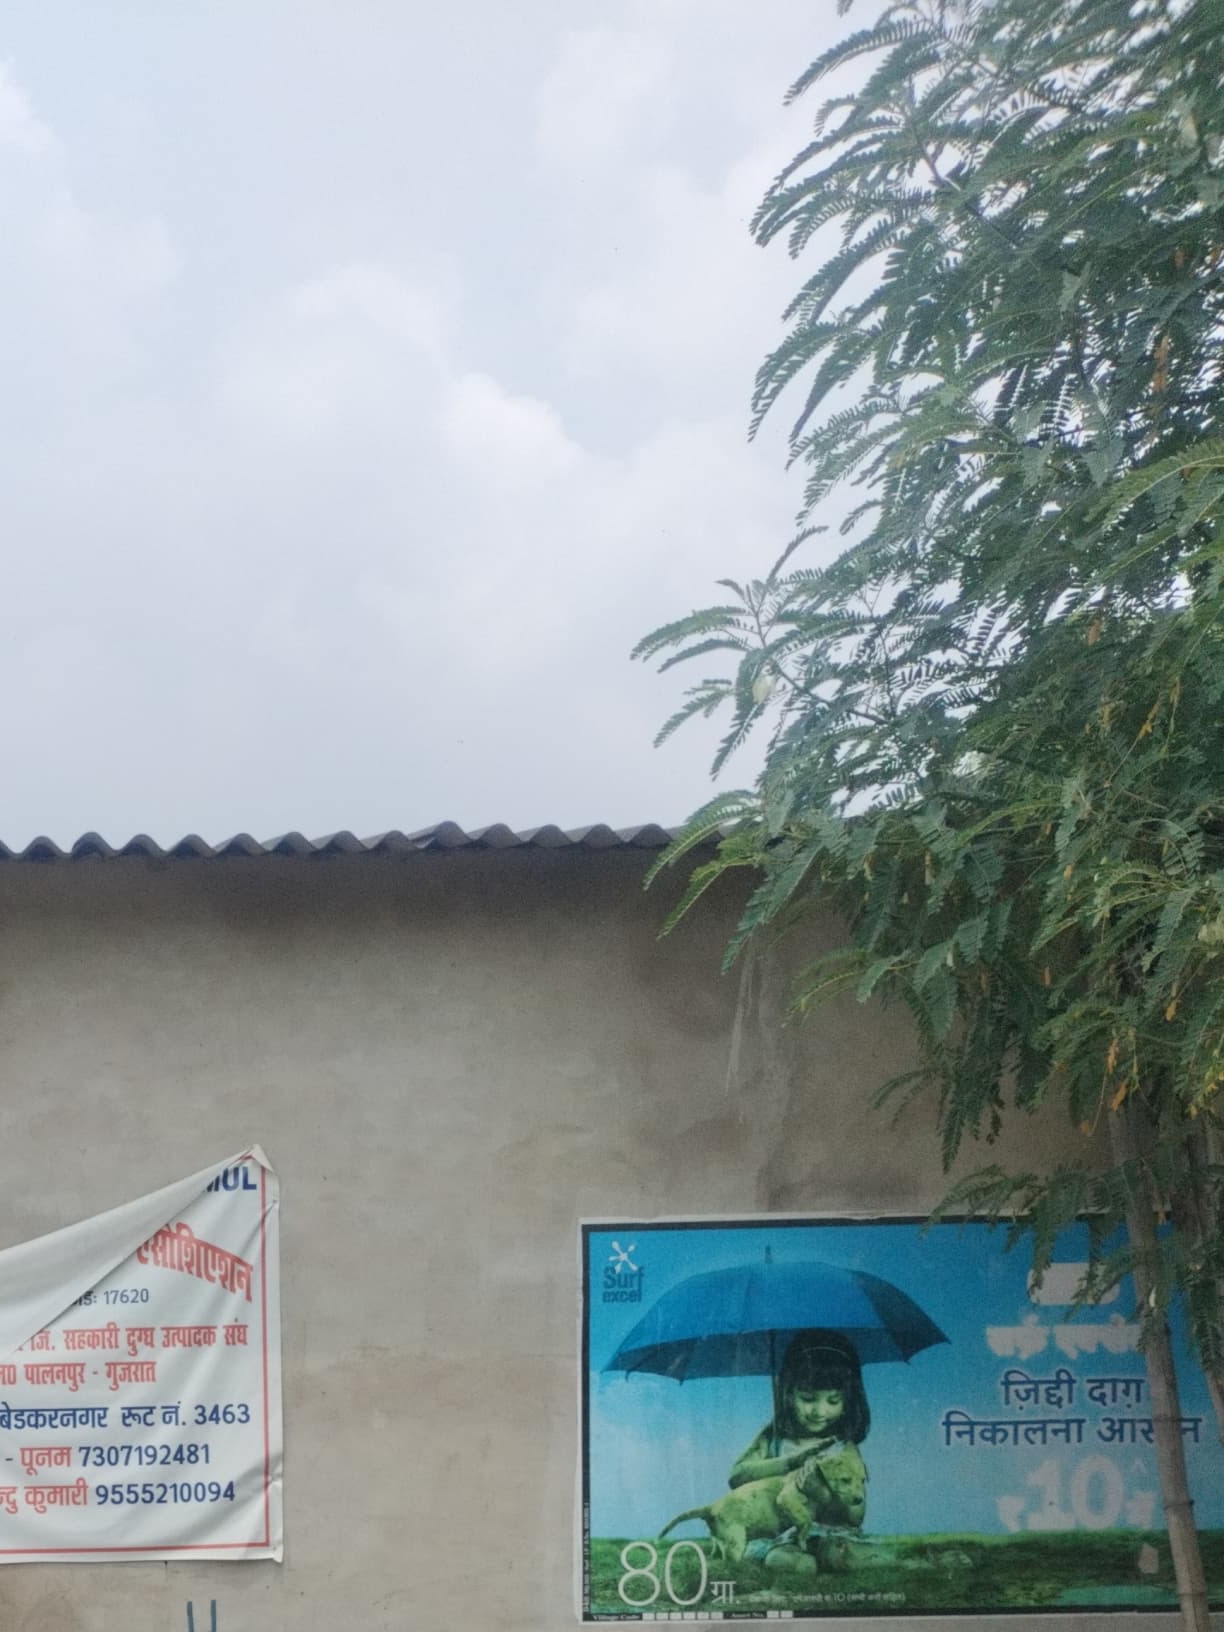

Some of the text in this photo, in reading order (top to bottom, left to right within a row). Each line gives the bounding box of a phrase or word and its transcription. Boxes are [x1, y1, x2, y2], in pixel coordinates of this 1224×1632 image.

[603, 1266, 645, 1291] Surf
[103, 1288, 150, 1305] 17620
[602, 1290, 642, 1303] excel
[63, 1321, 120, 1351] सहकारी
[161, 1325, 217, 1348] उत्पादक
[24, 1362, 86, 1393] पालनपुर
[105, 1361, 157, 1391] गुजरात
[194, 1403, 251, 1425] 3463
[942, 1410, 1086, 1446] निकालना
[20, 1446, 73, 1476] पूनम
[78, 1443, 211, 1467] 7307192481
[24, 1477, 89, 1514] कुमारी
[95, 1481, 236, 1506] 9555210094
[618, 1541, 707, 1607] 80
